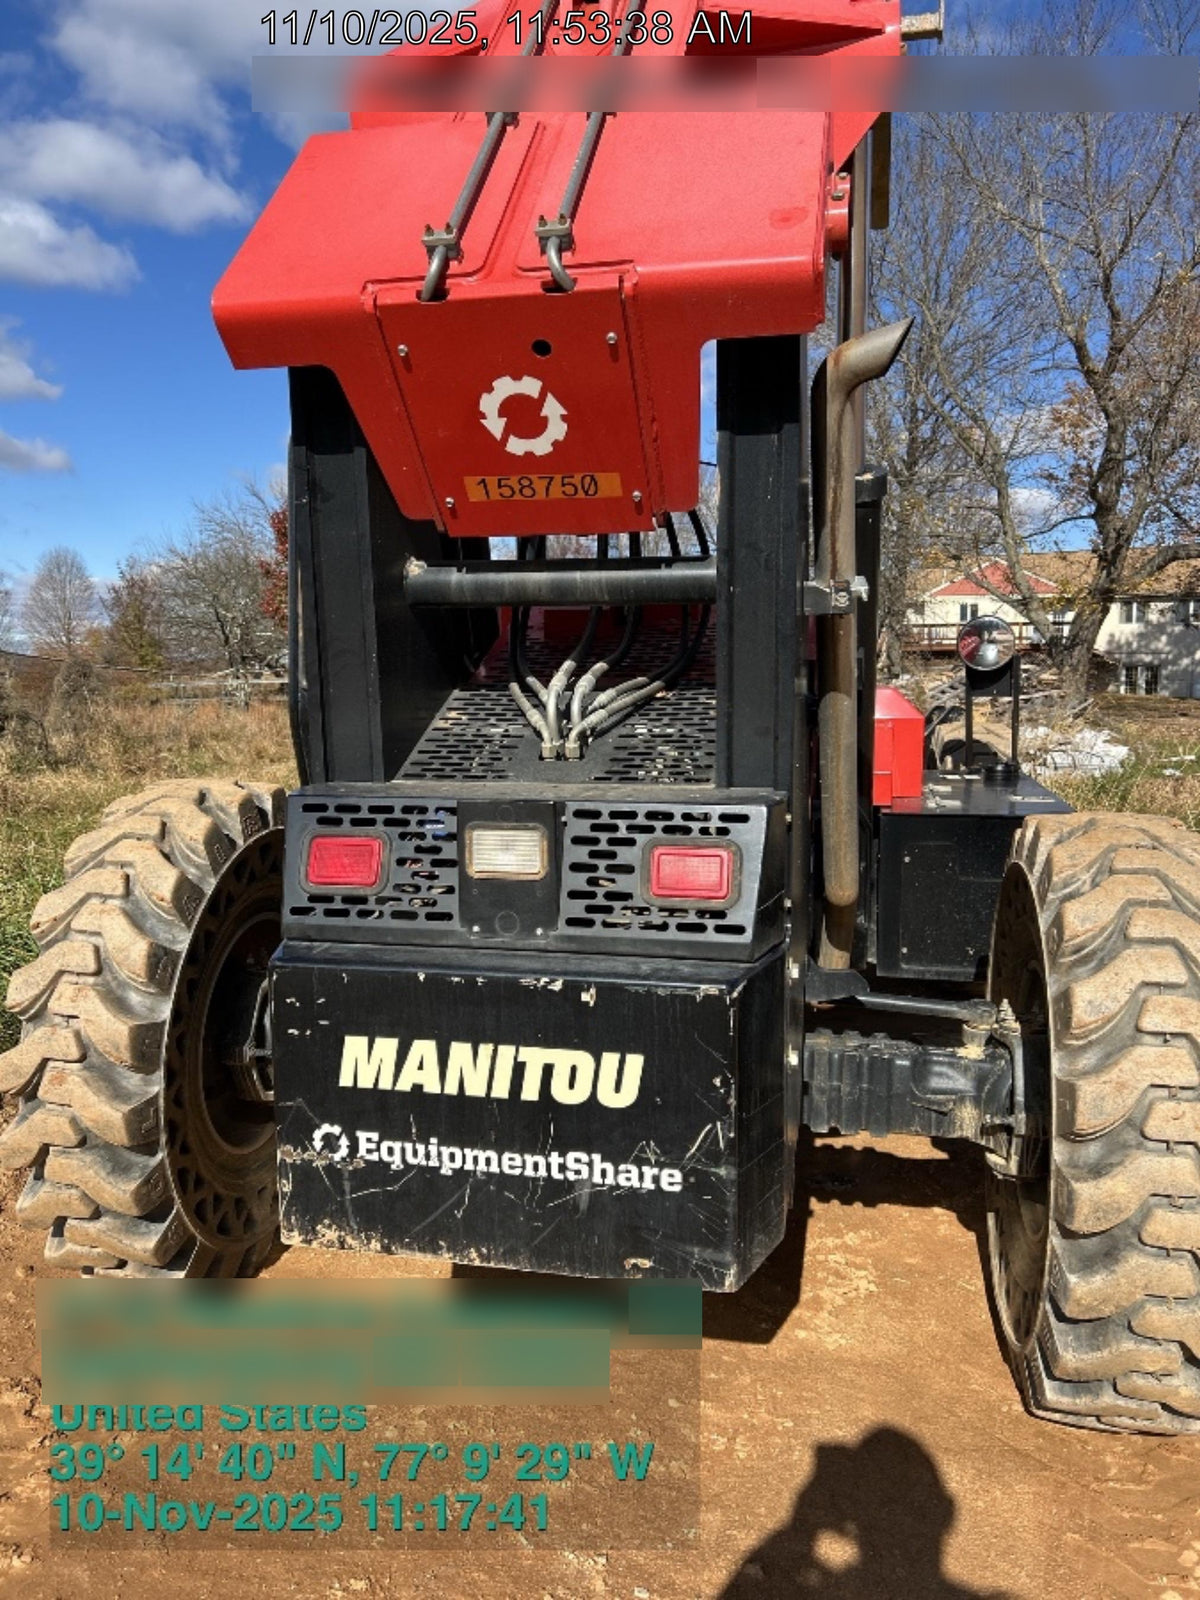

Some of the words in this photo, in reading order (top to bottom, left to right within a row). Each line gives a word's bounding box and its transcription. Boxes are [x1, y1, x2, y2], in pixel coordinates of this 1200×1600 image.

[476, 474, 598, 500] 158750
[338, 1035, 645, 1109] MANITOU
[355, 1130, 683, 1192] EquipmentShare
